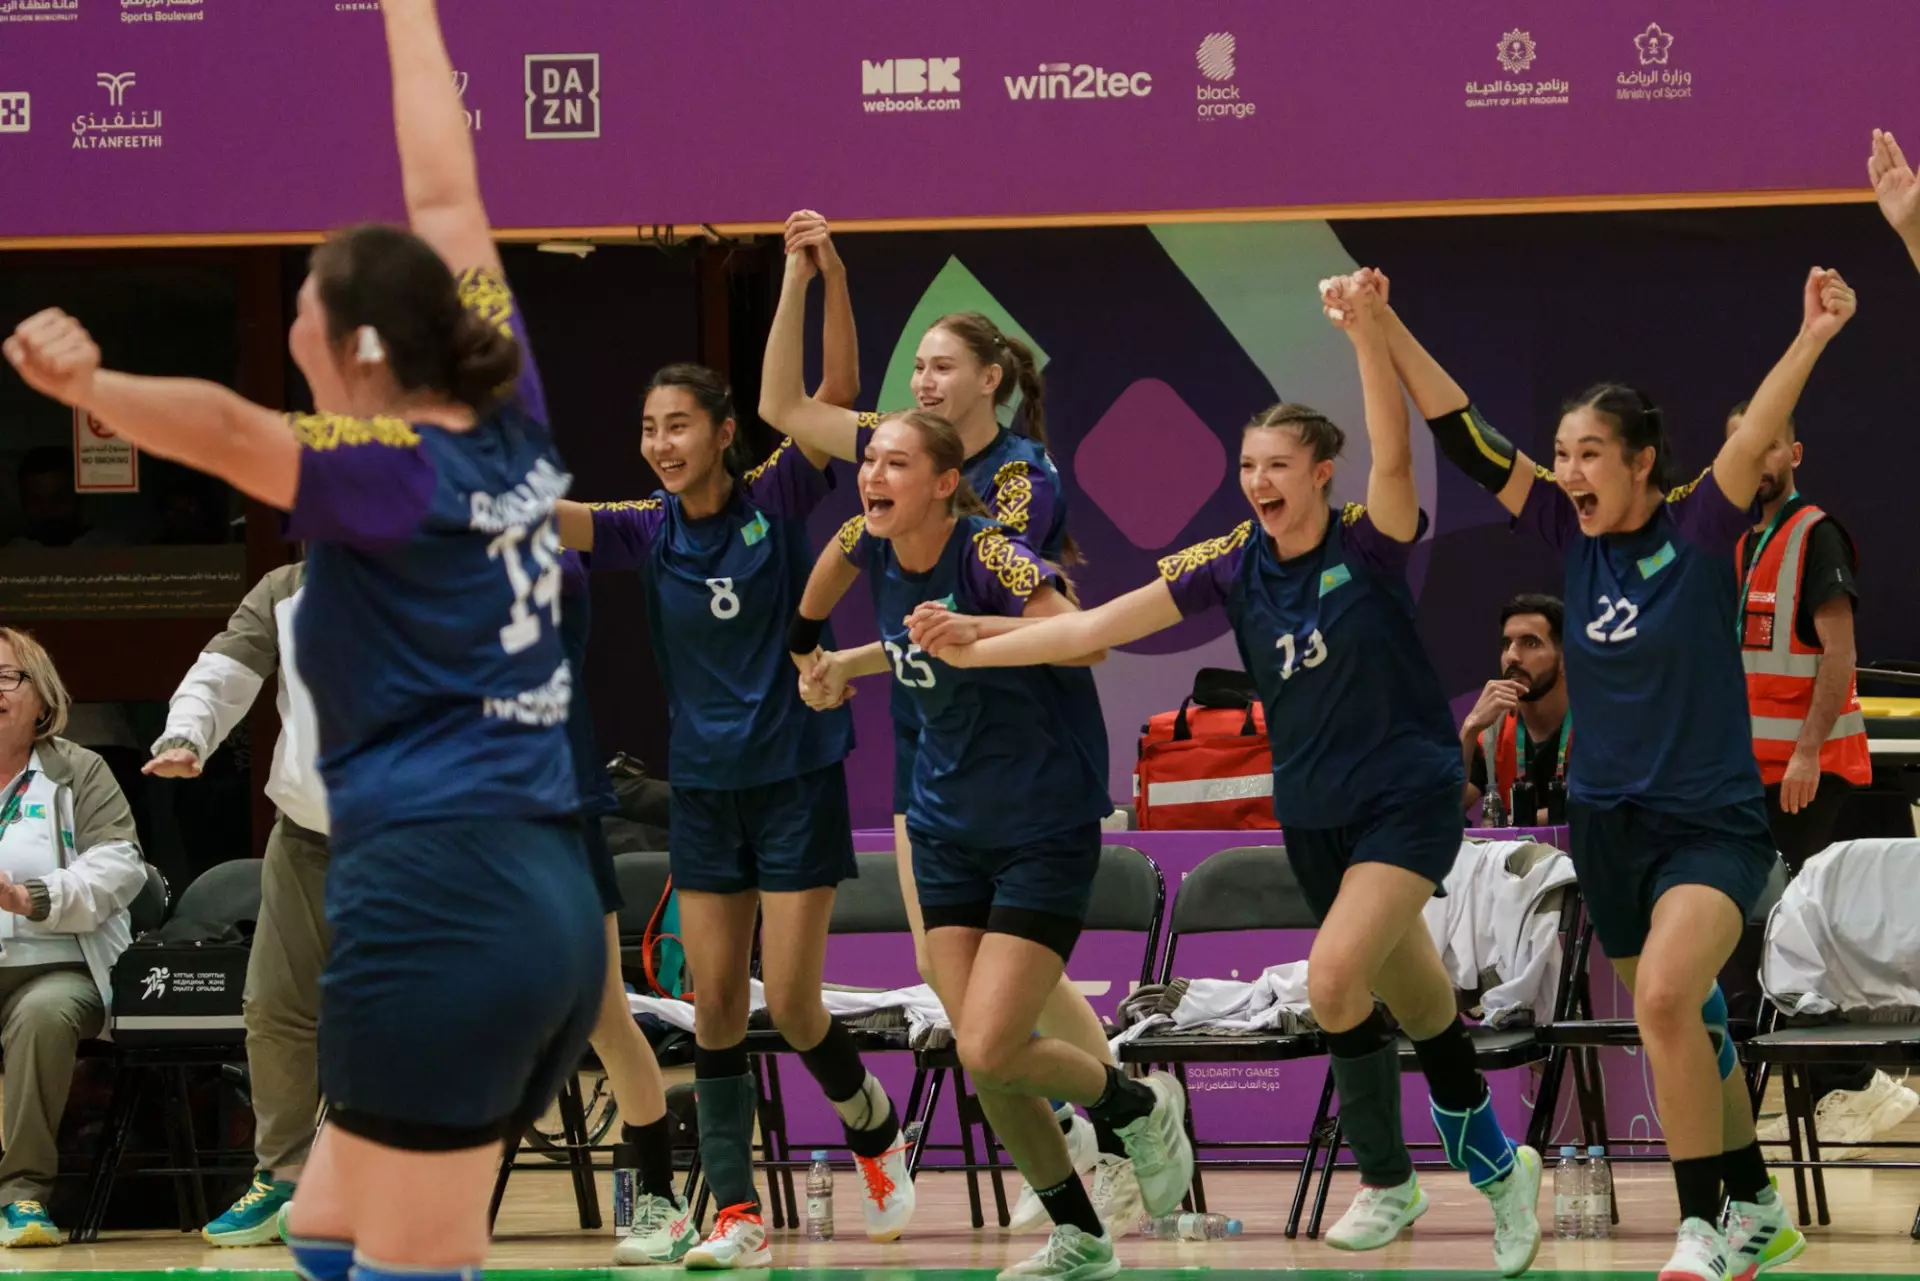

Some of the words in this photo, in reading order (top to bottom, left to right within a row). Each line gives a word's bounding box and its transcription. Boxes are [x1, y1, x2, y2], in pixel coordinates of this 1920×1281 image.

[335, 2, 379, 11] CINEMAS
[120, 12, 153, 23] Sports
[155, 11, 203, 21] Boulevard
[1004, 62, 1153, 100] win2tec
[1616, 70, 1659, 87] الرياضة
[1662, 69, 1692, 86] وزارة
[1197, 84, 1240, 100] black
[1503, 81, 1533, 95] جودة
[1535, 78, 1569, 95] برنامج
[1616, 88, 1651, 101] Ministry
[1664, 86, 1691, 99] Sport
[863, 97, 961, 112] webook.com
[1465, 99, 1498, 107] QUALITY
[1500, 98, 1510, 106] OF
[1511, 97, 1528, 105] LIFE
[1529, 96, 1569, 104] PROGRAM
[1198, 102, 1256, 118] orange
[72, 110, 162, 135] التنفيذي
[72, 135, 162, 149] ALTANFEETHI
[706, 577, 741, 620] 8
[1586, 595, 1639, 643] 22
[1189, 1068, 1243, 1078] SOLIDARITY
[1245, 1068, 1280, 1077] GAMES
[1260, 1080, 1280, 1091] دورة
